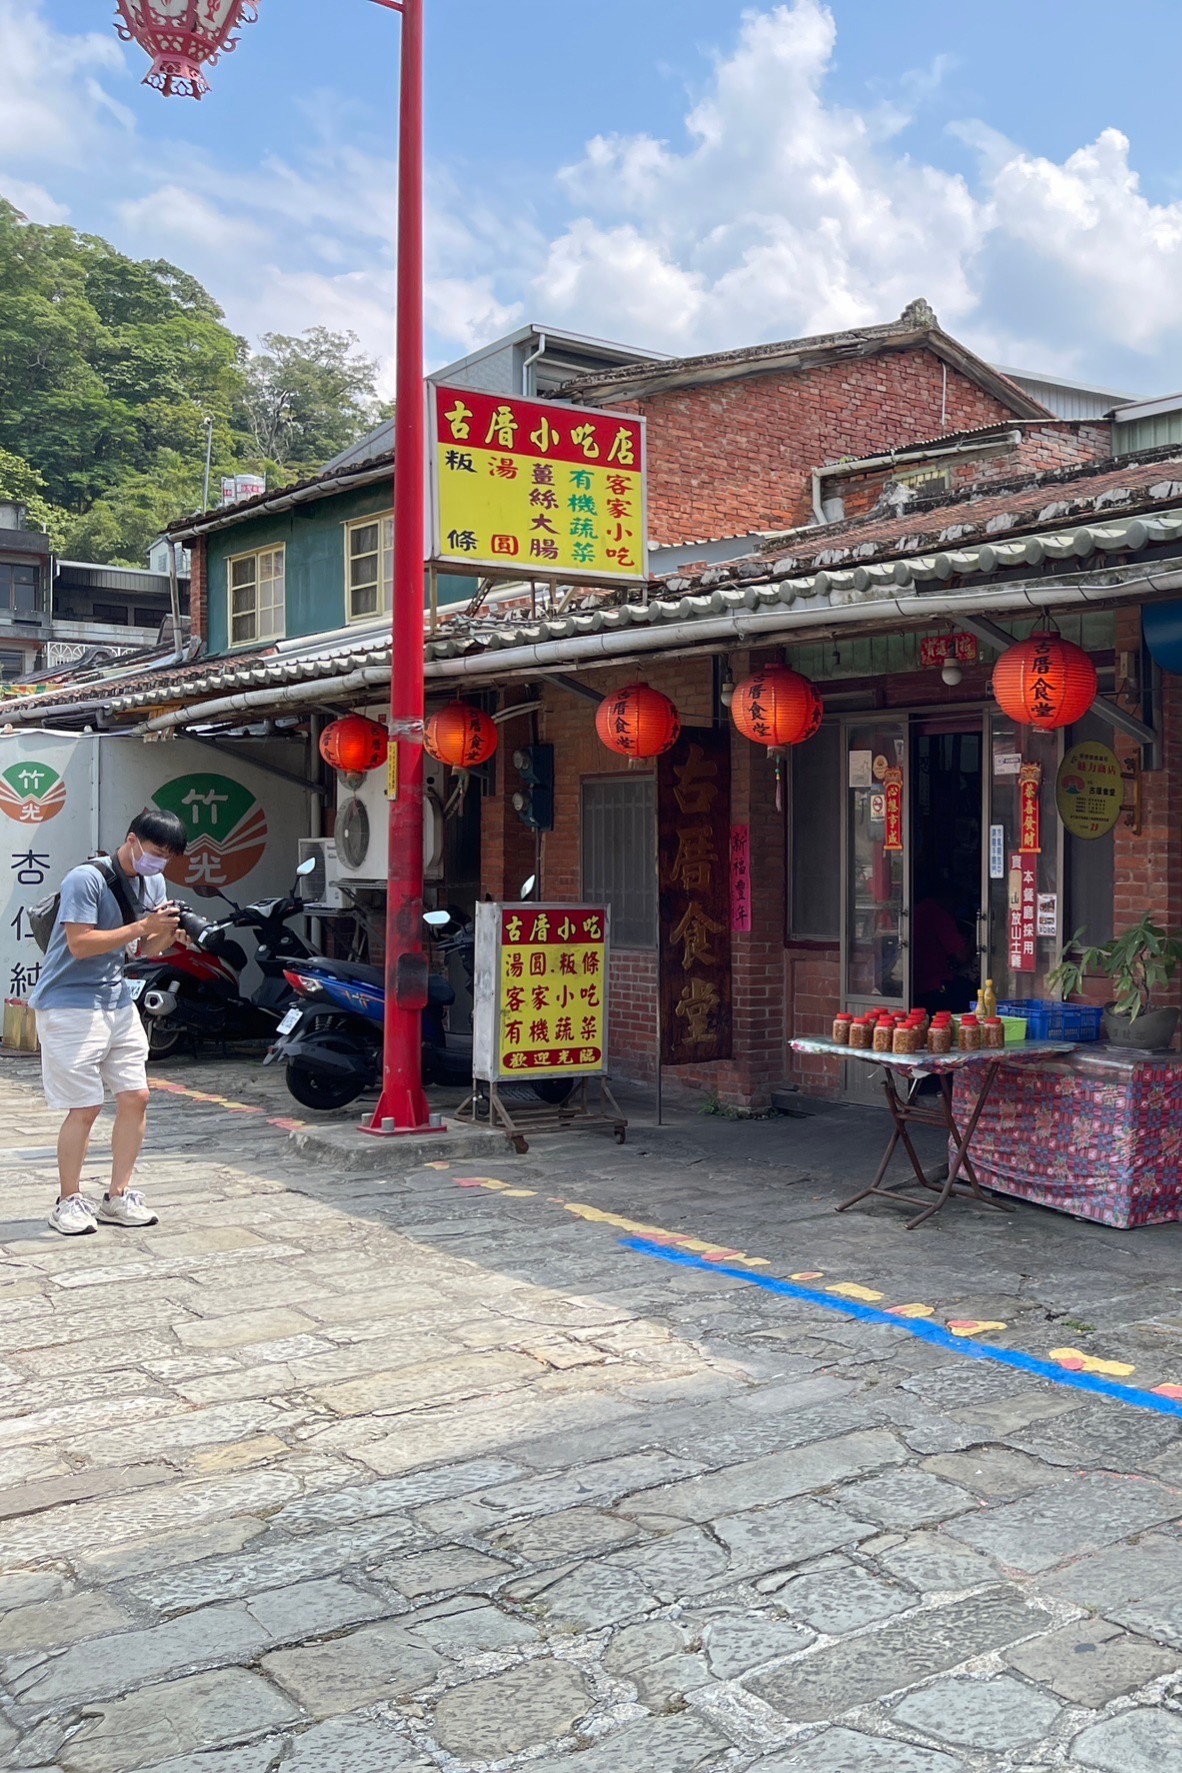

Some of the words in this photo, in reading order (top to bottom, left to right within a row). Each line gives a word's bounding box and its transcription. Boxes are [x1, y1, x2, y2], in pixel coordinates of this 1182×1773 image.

[444, 400, 635, 466] 古厝小吃店
[445, 450, 479, 551] 粄條
[488, 456, 519, 556] 湯圓
[528, 463, 560, 560] 薑絲大腸
[567, 469, 598, 563] 有機蔬菜
[606, 474, 634, 566] 客家小吃
[747, 673, 772, 737] 古厝食堂
[1030, 641, 1056, 718] 古厝食堂
[613, 690, 635, 749] 古厝食堂
[1023, 783, 1036, 848] 恭喜發財
[505, 913, 601, 943] 古厝小吃
[670, 742, 726, 1048] 古厝食堂
[505, 1016, 597, 1045] 有機蔬菜
[506, 983, 600, 1012] 客家小吃
[509, 1049, 596, 1069] 歡迎光臨
